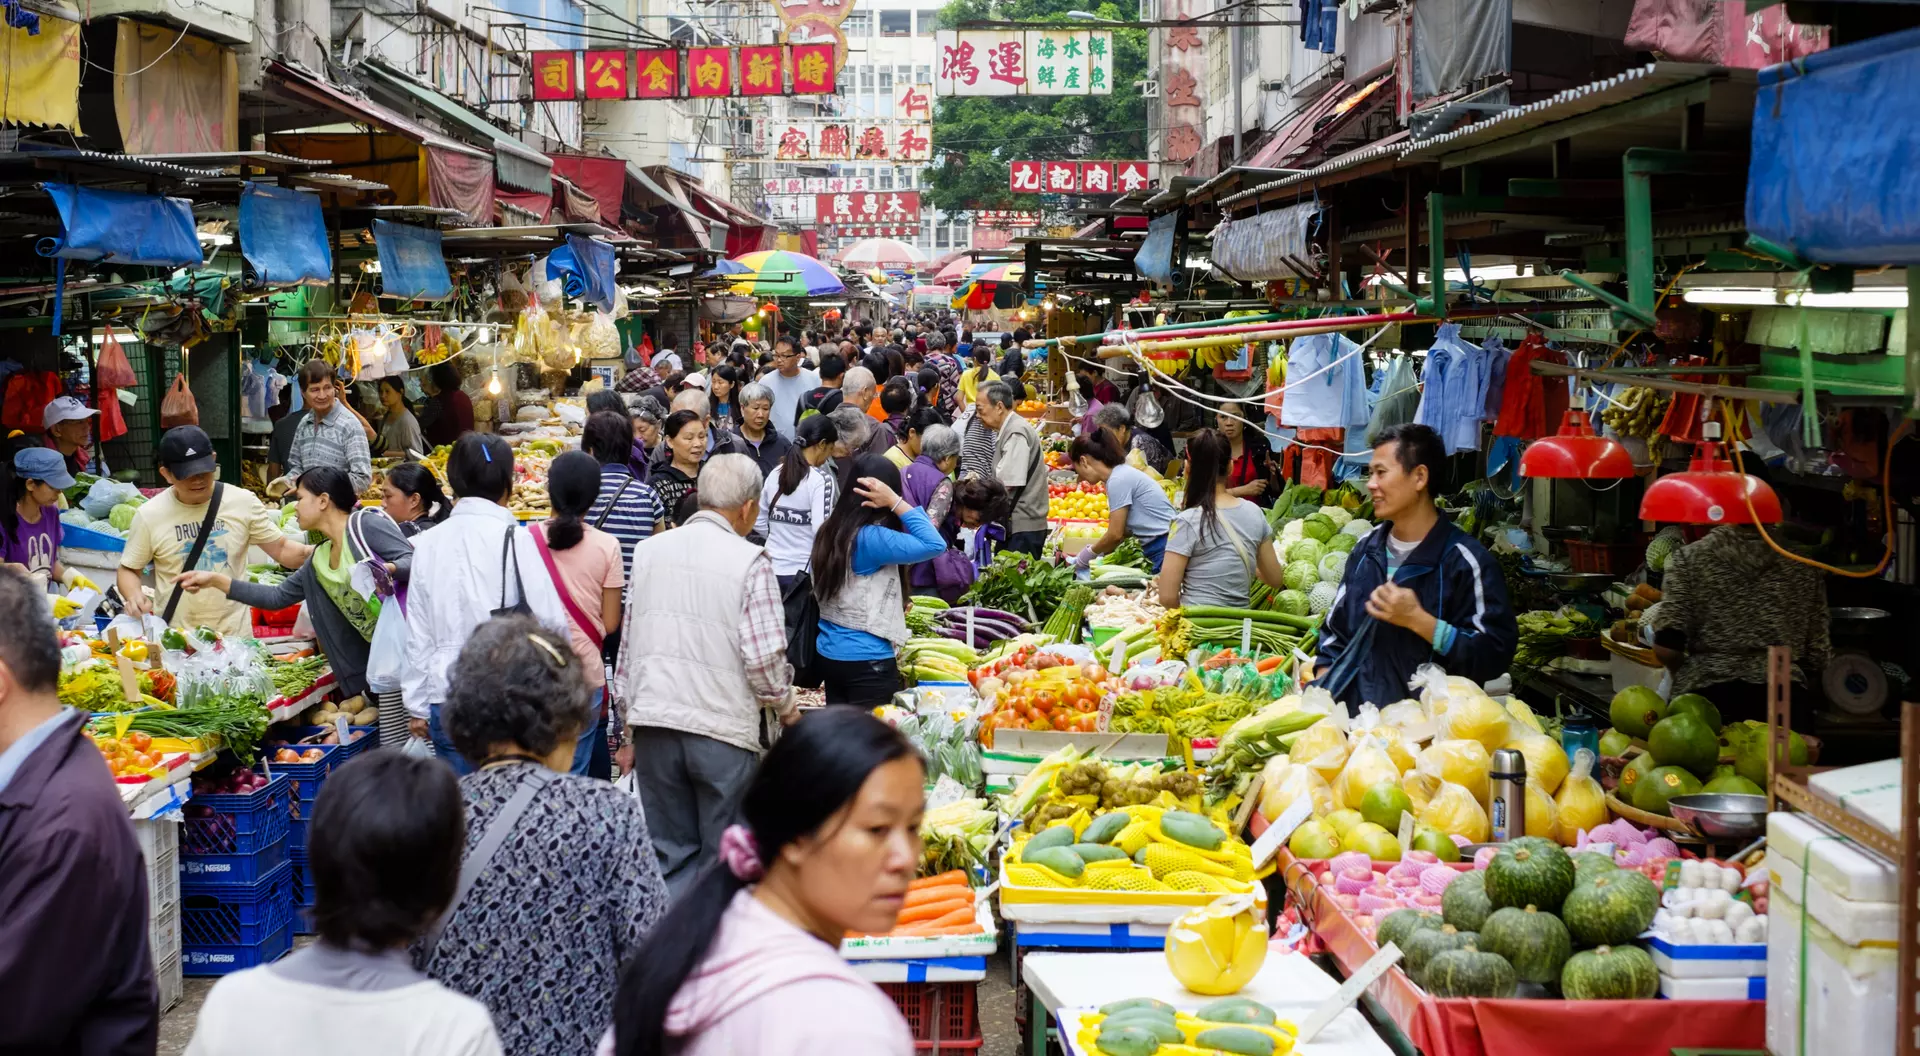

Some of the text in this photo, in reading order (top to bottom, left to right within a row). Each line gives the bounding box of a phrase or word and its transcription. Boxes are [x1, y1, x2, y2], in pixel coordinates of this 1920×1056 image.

[941, 40, 1028, 86] 鴻運
[1014, 164, 1146, 192] 九記肉食
[833, 193, 906, 214] 大昌隆
